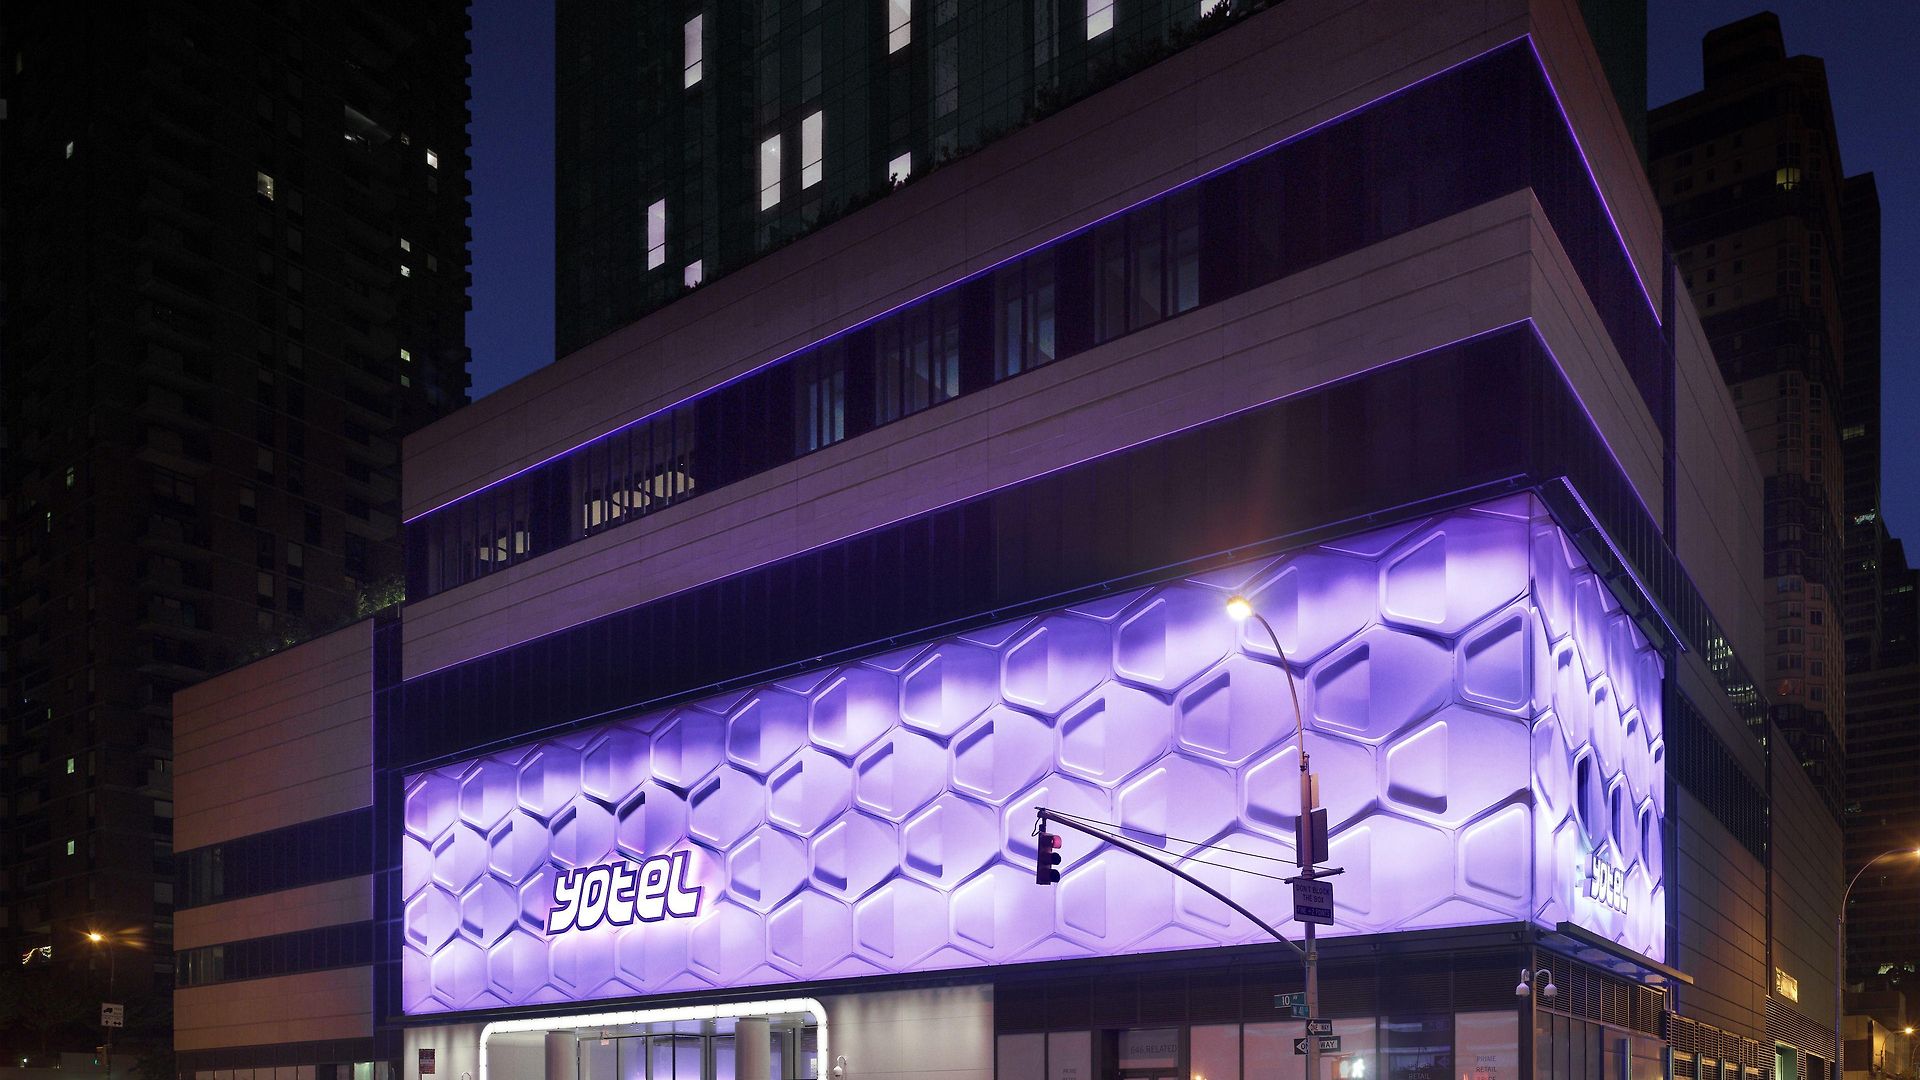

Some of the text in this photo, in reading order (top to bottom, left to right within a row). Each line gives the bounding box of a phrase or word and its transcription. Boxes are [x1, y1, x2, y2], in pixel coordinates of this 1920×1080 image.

[1312, 886, 1330, 895] BLOCK
[1303, 893, 1324, 903] THE BOX
[1282, 995, 1290, 1006] 10
[1319, 1040, 1335, 1049] WAY
